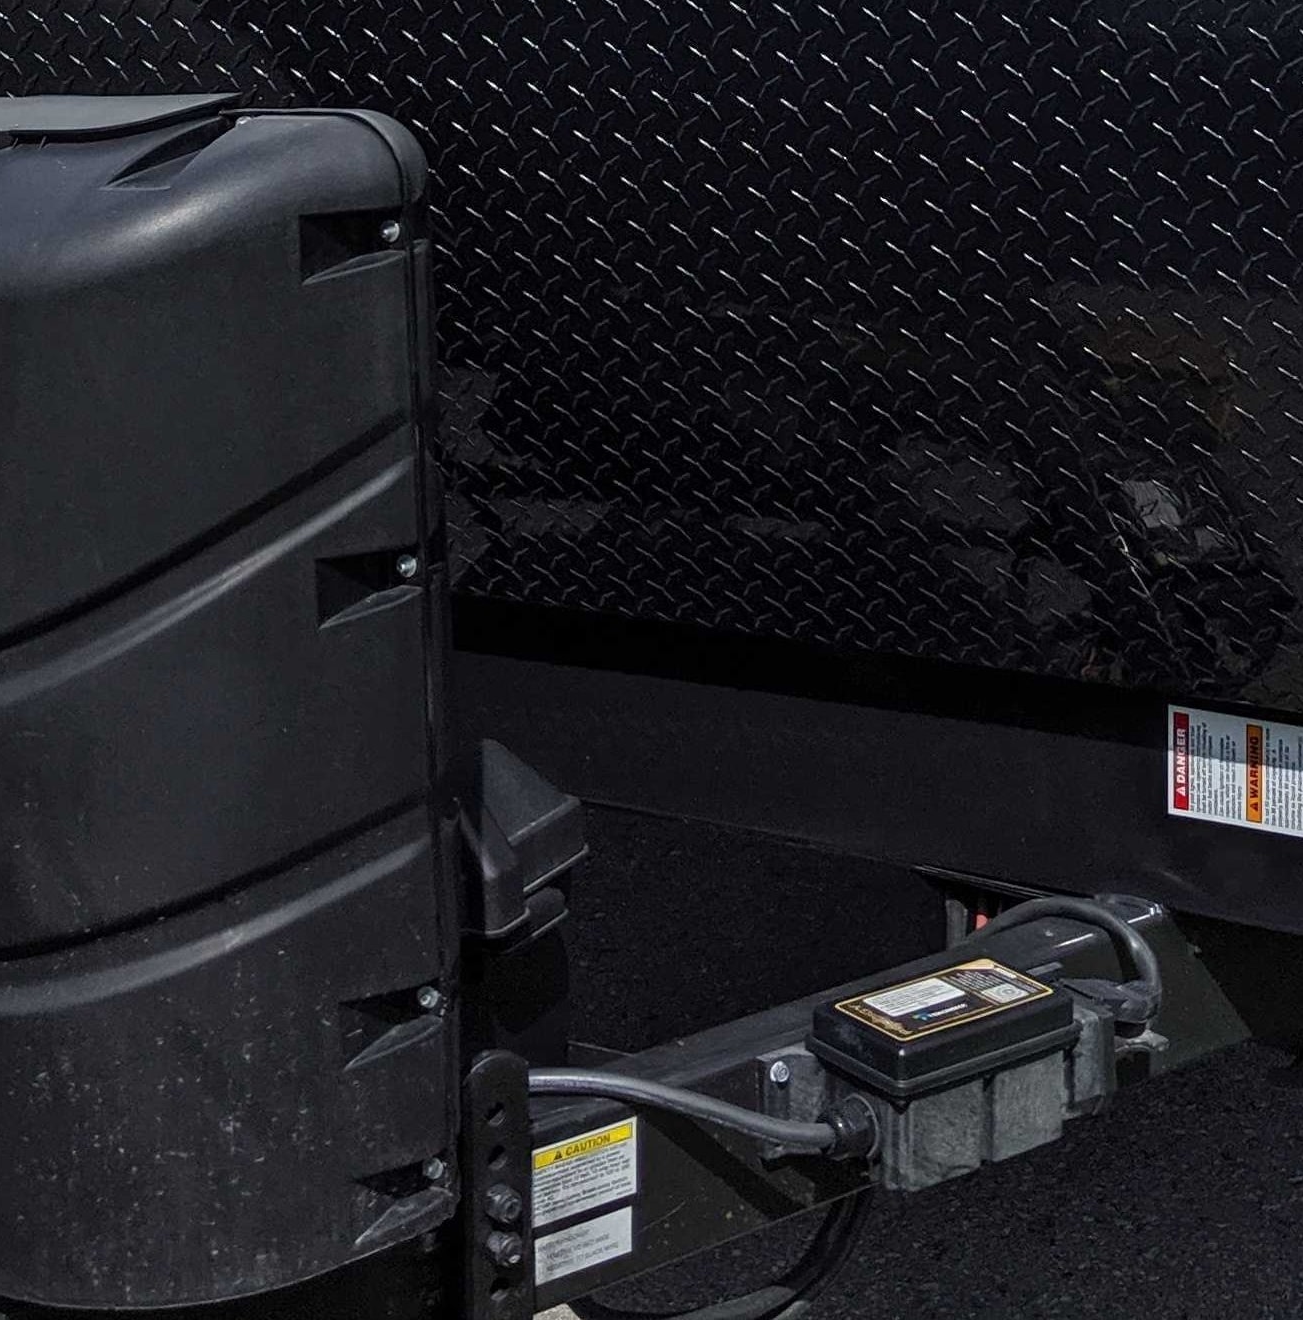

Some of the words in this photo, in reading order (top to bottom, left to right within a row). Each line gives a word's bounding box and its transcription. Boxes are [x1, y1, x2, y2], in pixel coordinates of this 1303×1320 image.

[1177, 727, 1186, 788] DANGER
[1249, 735, 1261, 800] WARNING
[565, 1133, 611, 1157] CAUTION
